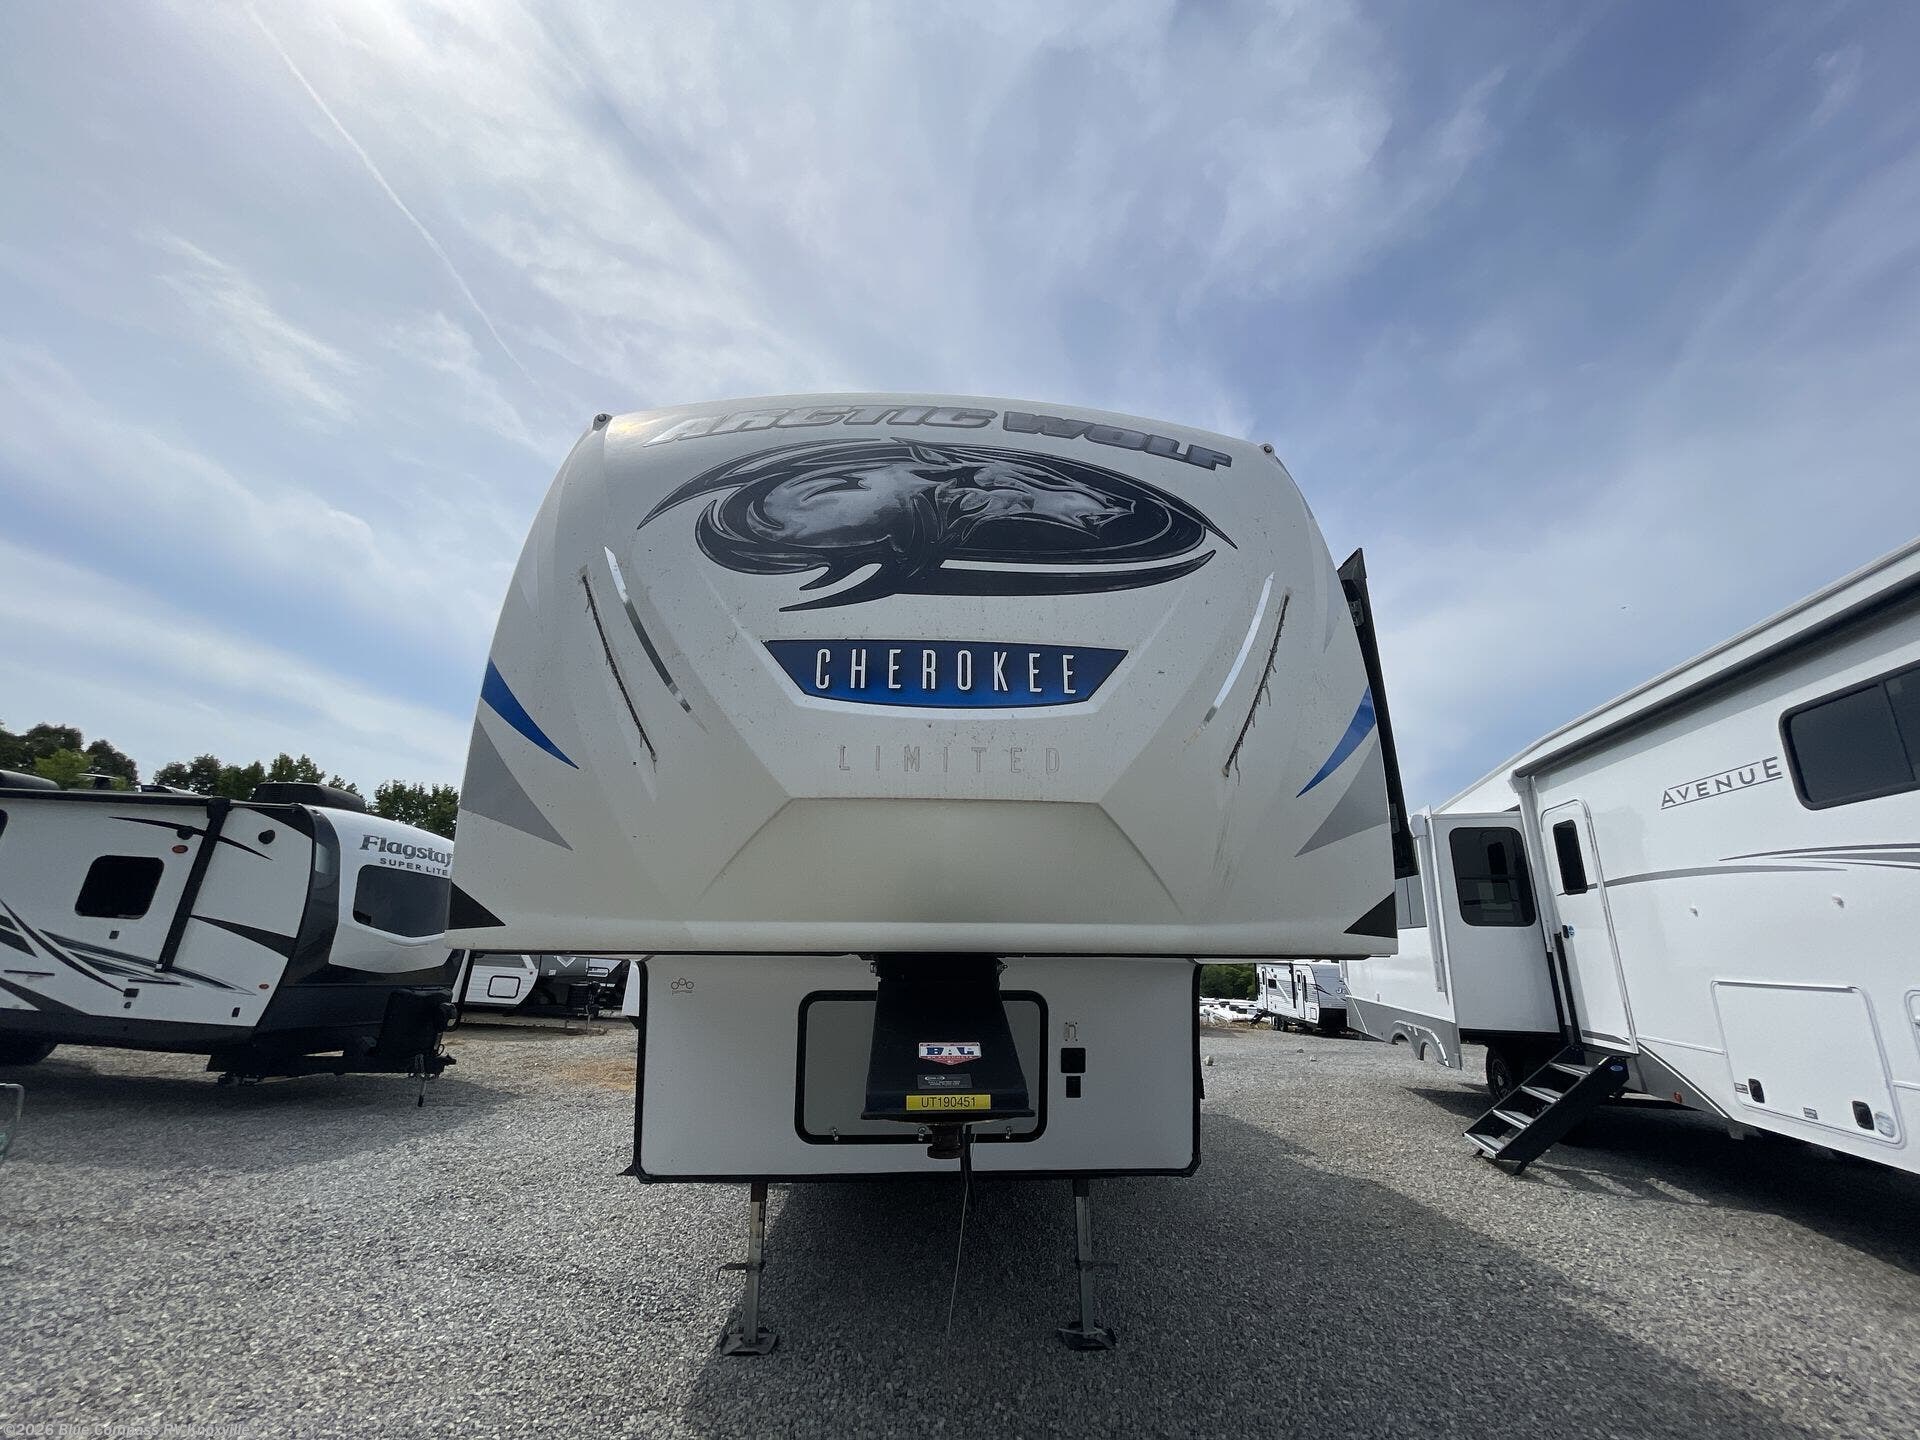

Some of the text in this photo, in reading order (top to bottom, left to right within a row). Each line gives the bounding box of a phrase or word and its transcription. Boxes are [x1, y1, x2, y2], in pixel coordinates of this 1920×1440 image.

[643, 405, 1232, 470] ARCTIC WOLF
[815, 649, 1077, 694] CHEROKEE
[839, 745, 1060, 773] LIMITED
[1661, 756, 1782, 807] AVENUE
[359, 834, 453, 867] Flagstaf
[380, 857, 449, 876] SUPER LITE
[921, 1096, 977, 1108] UT190451
